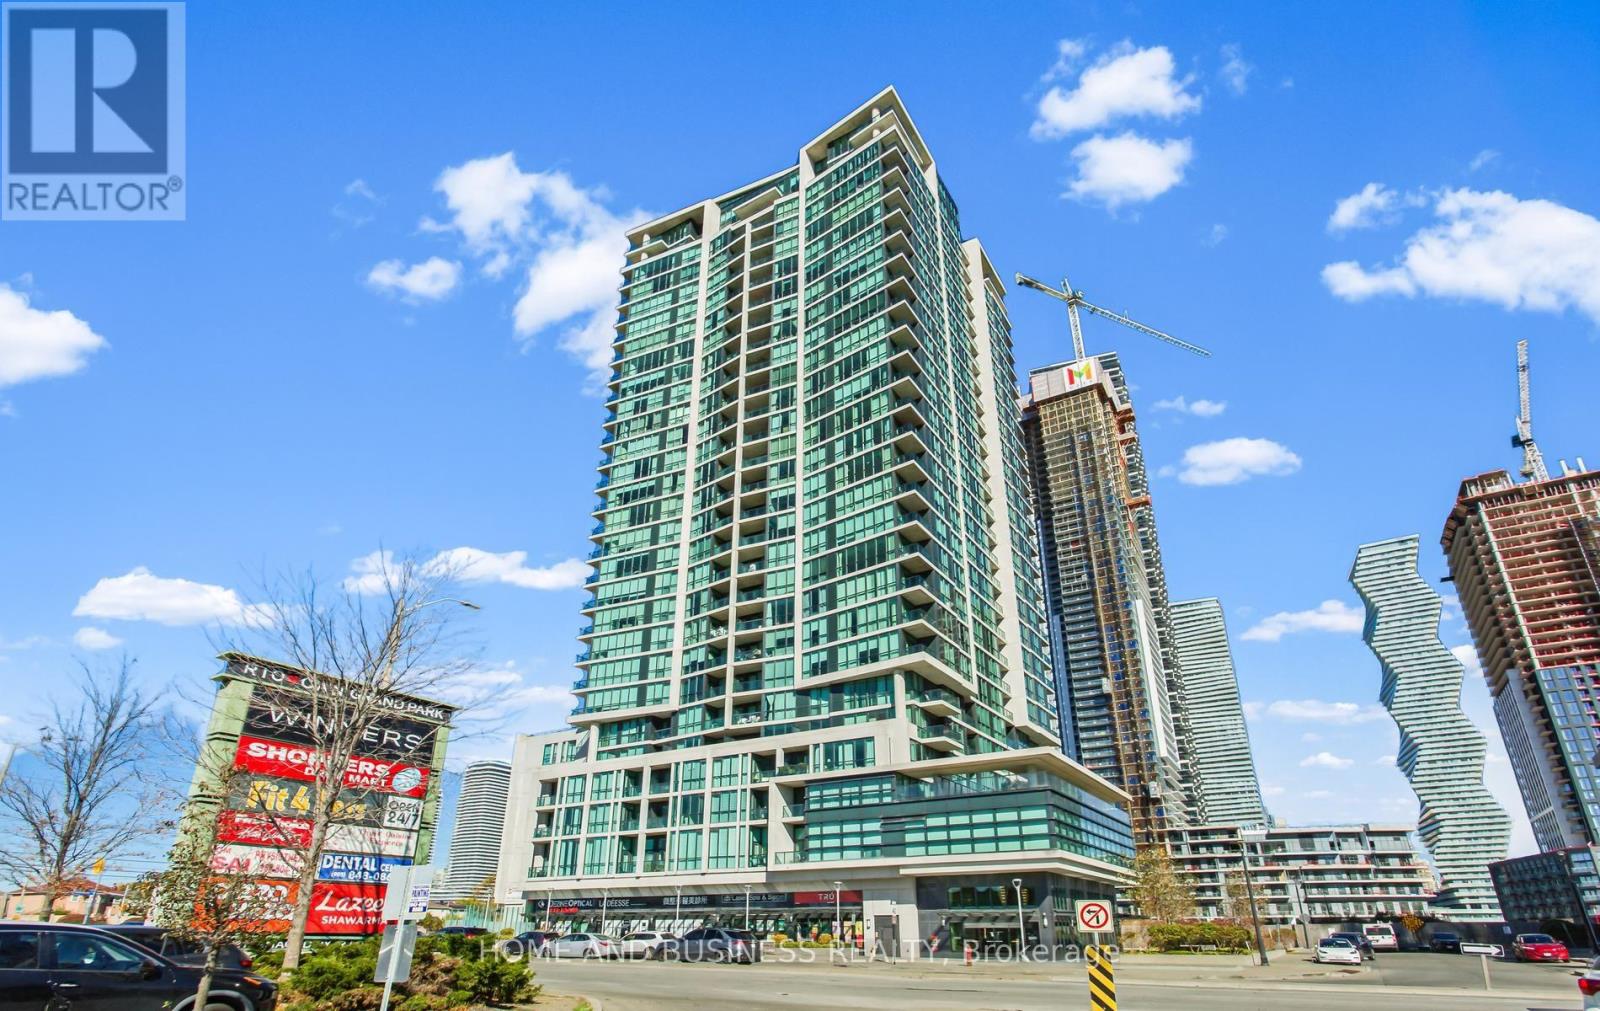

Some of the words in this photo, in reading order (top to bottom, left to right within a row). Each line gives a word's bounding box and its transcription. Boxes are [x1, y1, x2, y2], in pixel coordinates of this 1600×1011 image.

[407, 702, 444, 720] PARK
[271, 706, 421, 750] WINERS
[349, 774, 388, 787] MART
[387, 810, 419, 826] 24/7
[322, 854, 377, 873] DENTAL
[568, 899, 592, 907] OPTICAL
